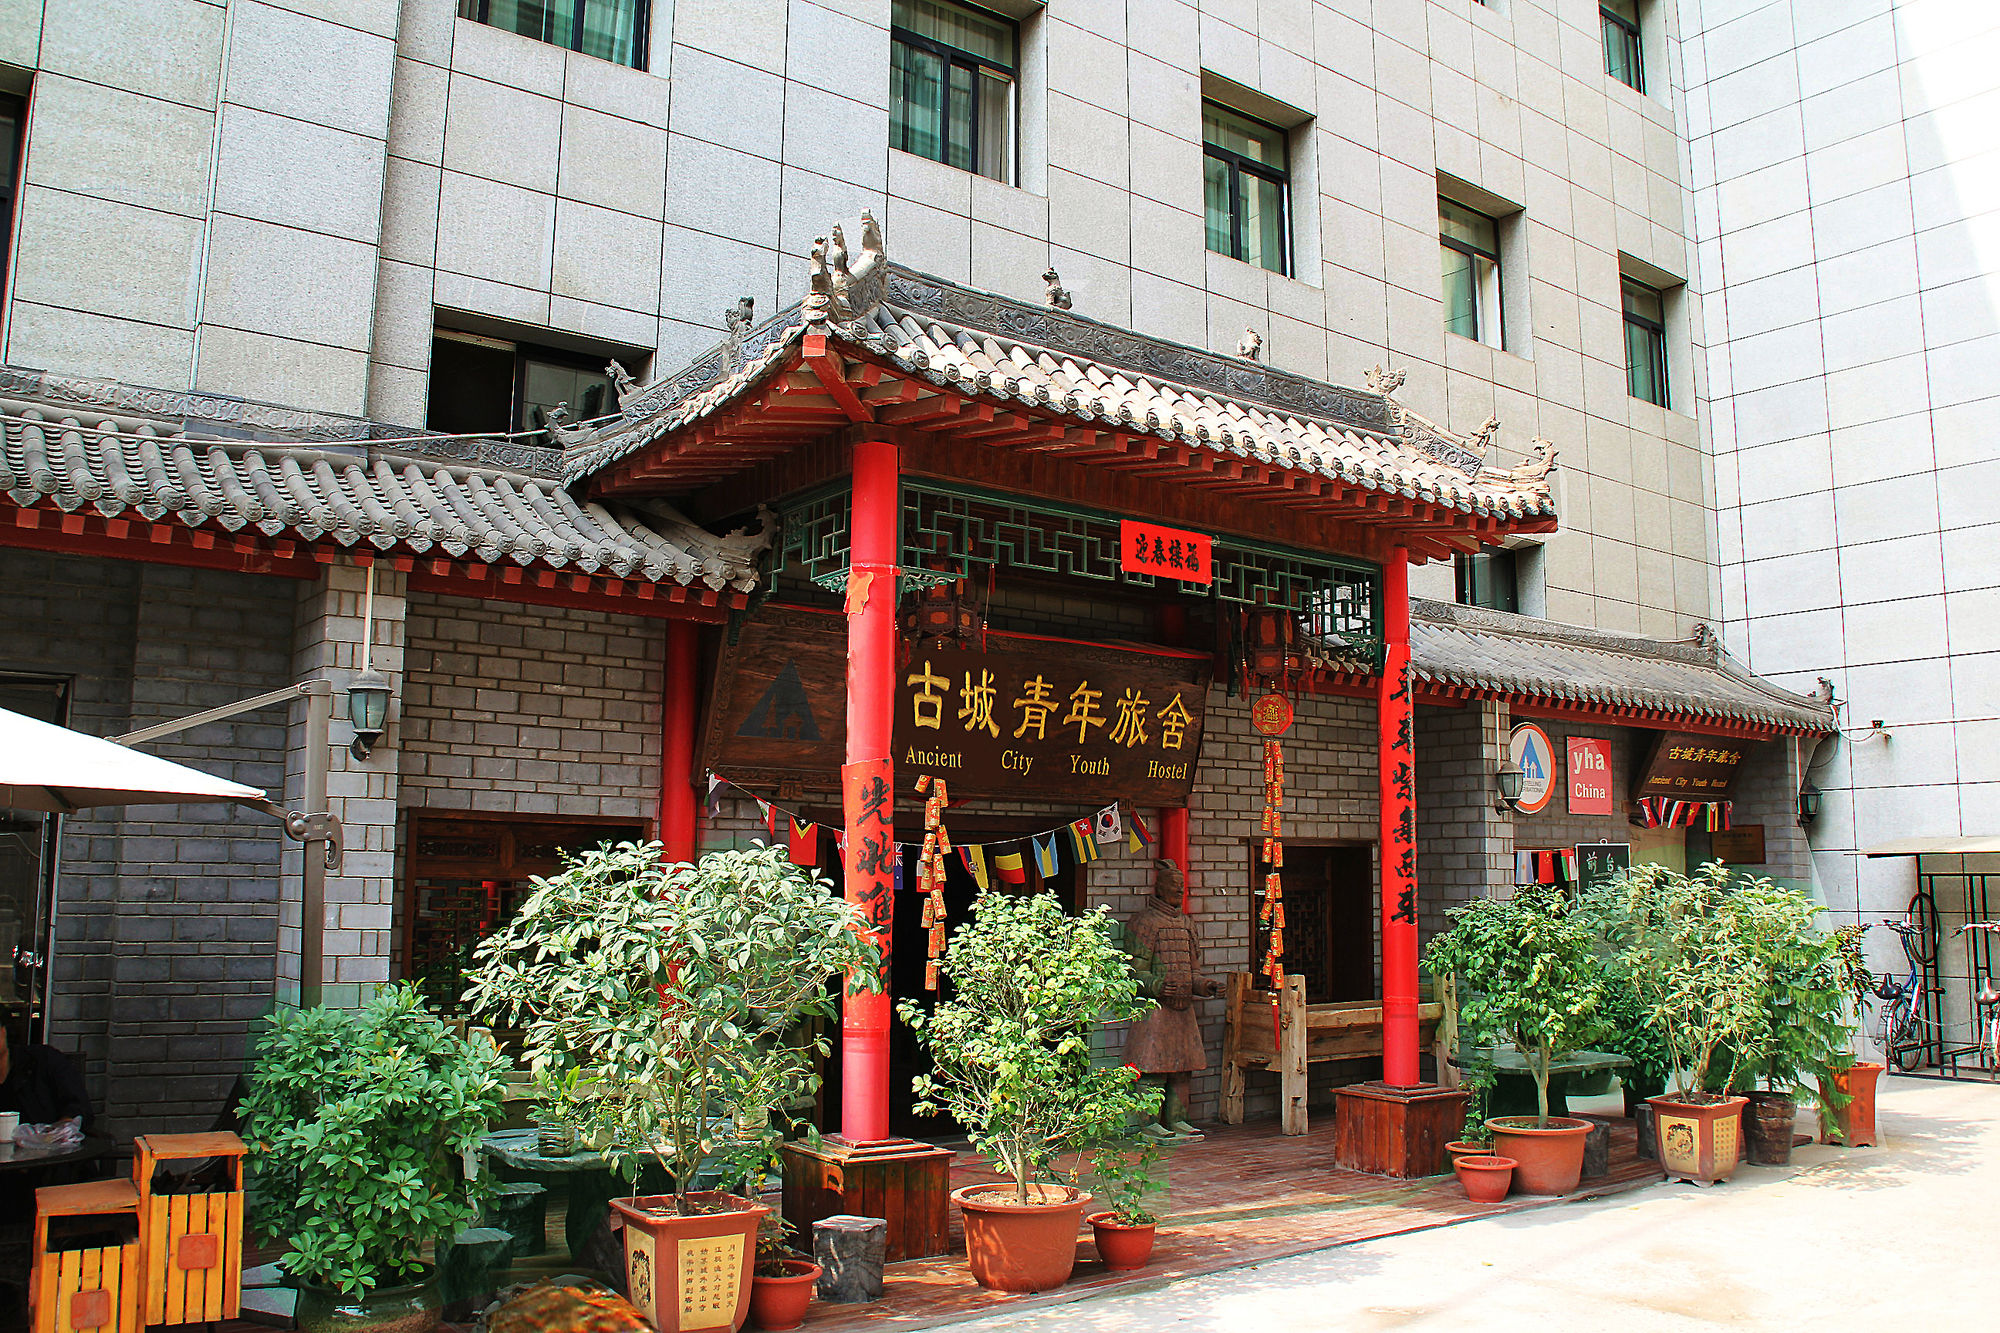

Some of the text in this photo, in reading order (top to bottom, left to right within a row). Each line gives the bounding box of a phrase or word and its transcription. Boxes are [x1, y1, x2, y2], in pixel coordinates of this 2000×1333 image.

[906, 659, 1193, 751] 古城青年旅舍
[905, 745, 1188, 780] Ancient City Youth Hostel
[1573, 746, 1605, 775] yha
[1668, 746, 1742, 765] 古城青年旅舍
[1575, 782, 1606, 799] China
